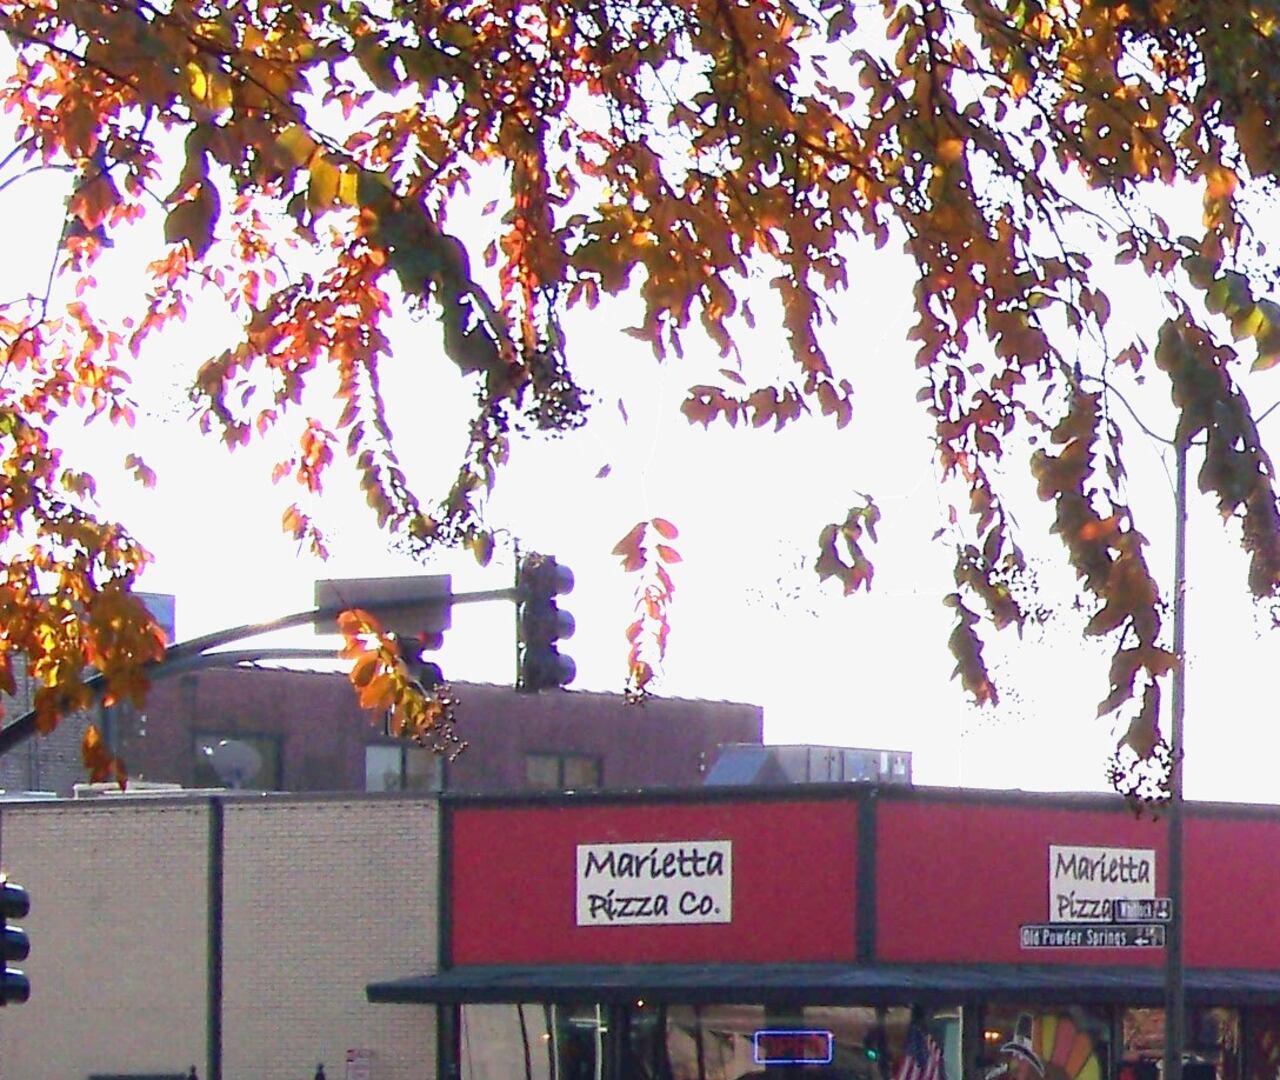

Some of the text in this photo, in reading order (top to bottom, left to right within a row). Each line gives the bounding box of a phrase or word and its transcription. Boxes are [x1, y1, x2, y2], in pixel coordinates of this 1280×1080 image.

[584, 847, 724, 879] Marietta
[1055, 851, 1150, 884] Marietta
[587, 888, 721, 921] Pizza Co.
[1056, 889, 1112, 919] Pizza
[1022, 928, 1039, 945] Old
[1042, 928, 1082, 946] Powder
[1086, 929, 1127, 947] Springs
